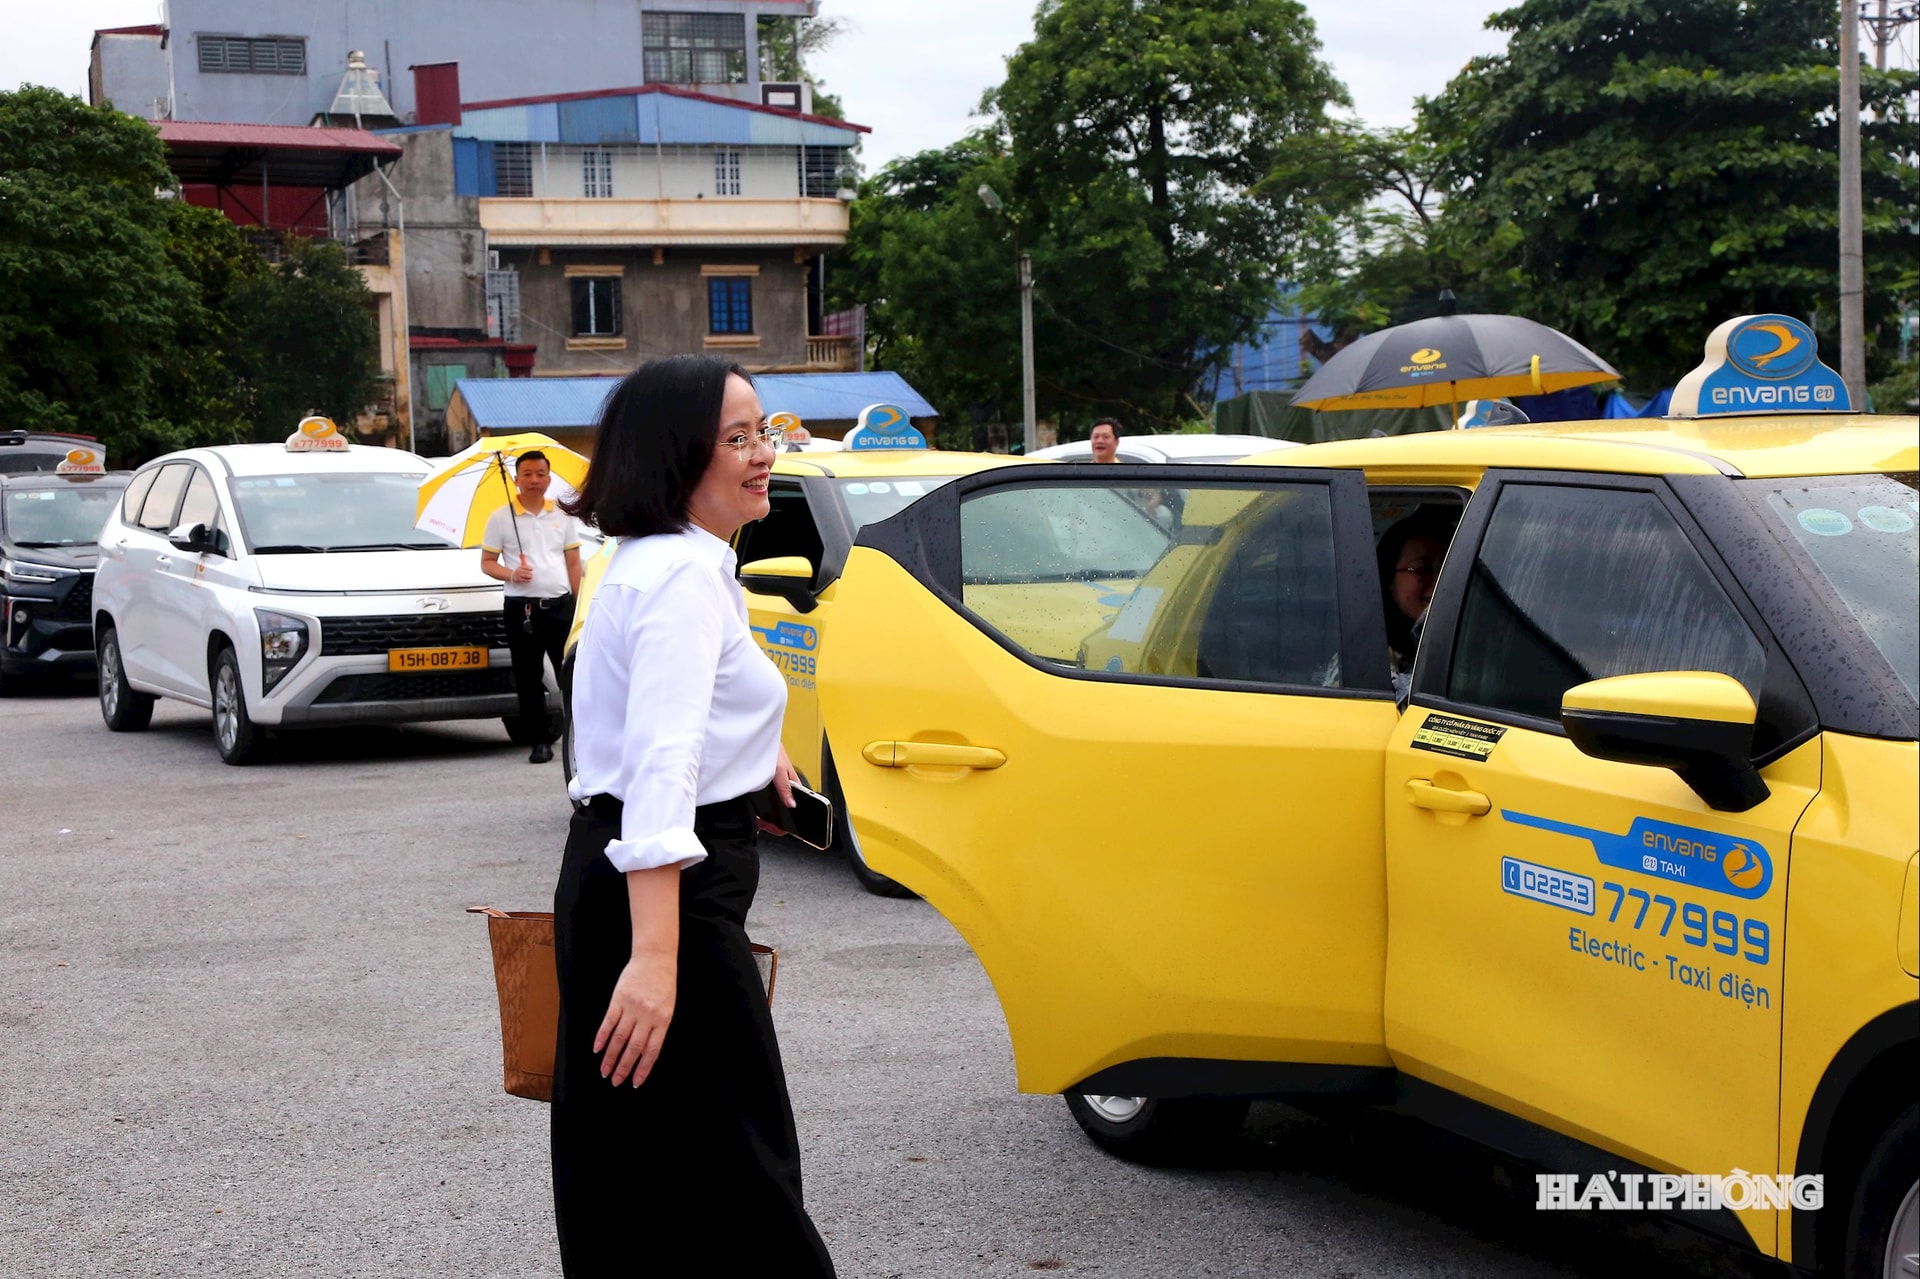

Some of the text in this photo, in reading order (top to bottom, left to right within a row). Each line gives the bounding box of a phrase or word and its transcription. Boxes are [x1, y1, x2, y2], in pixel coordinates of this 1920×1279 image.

[400, 651, 480, 667] 15H-087.38
[1660, 860, 1686, 877] TAXI
[1524, 870, 1770, 965] 0225.3 777999
[1568, 927, 1646, 971] Electric
[1665, 954, 1711, 991] Taxi
[1719, 973, 1770, 1010] điện
